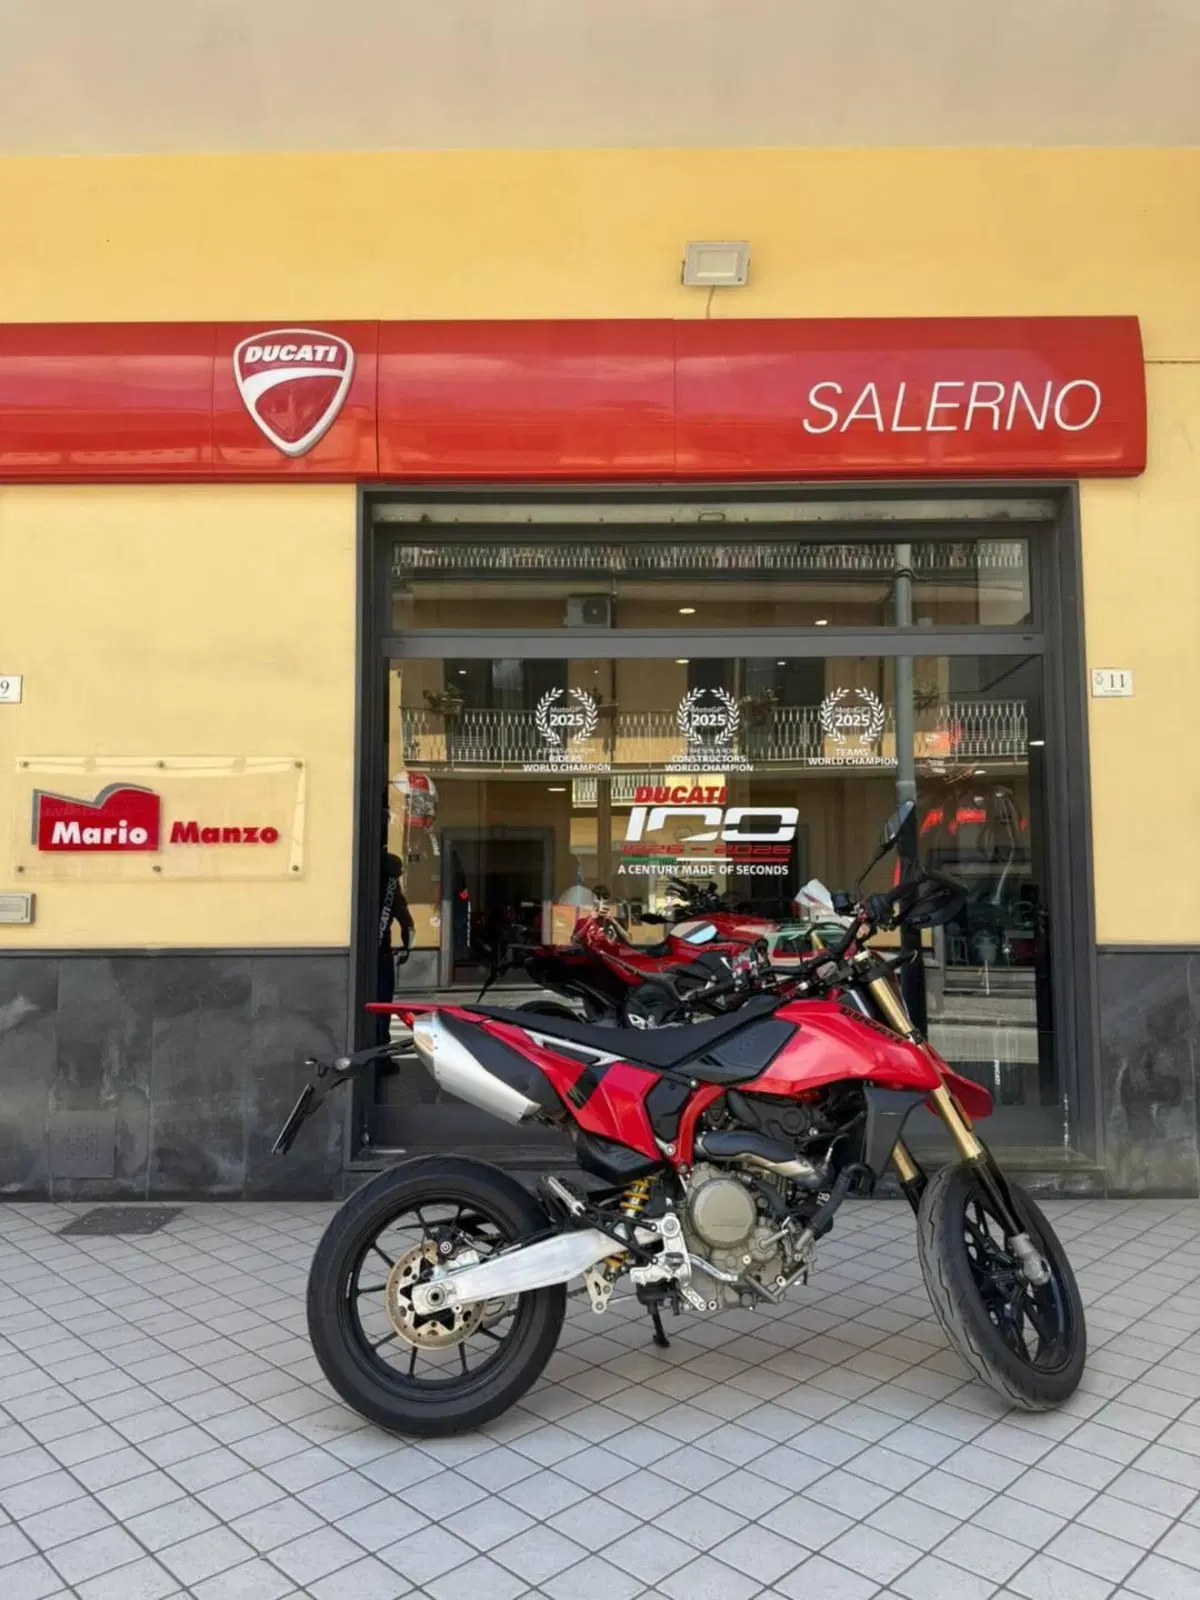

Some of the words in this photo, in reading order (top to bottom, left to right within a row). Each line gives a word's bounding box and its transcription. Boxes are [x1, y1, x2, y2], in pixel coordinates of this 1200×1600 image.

[244, 344, 338, 363] DUCATI
[802, 379, 1101, 433] SALERNO
[1110, 674, 1125, 688] 11
[550, 714, 584, 727] 2025
[692, 714, 727, 727] 2025
[835, 714, 870, 727] 2025
[523, 763, 558, 772] WORLD
[560, 763, 611, 772] CHAMPION
[665, 763, 700, 772] WORLD
[702, 763, 754, 772] CHAMPION
[808, 757, 844, 766] WORLD
[846, 757, 899, 766] CHAMPION
[634, 786, 728, 804] DUCATI
[51, 819, 149, 845] Mario
[170, 821, 280, 845] Manzo
[618, 865, 627, 876] A
[628, 865, 679, 876] CENTURY
[682, 865, 716, 876] MADE
[719, 865, 735, 876] OF
[736, 865, 790, 876] SECONDS
